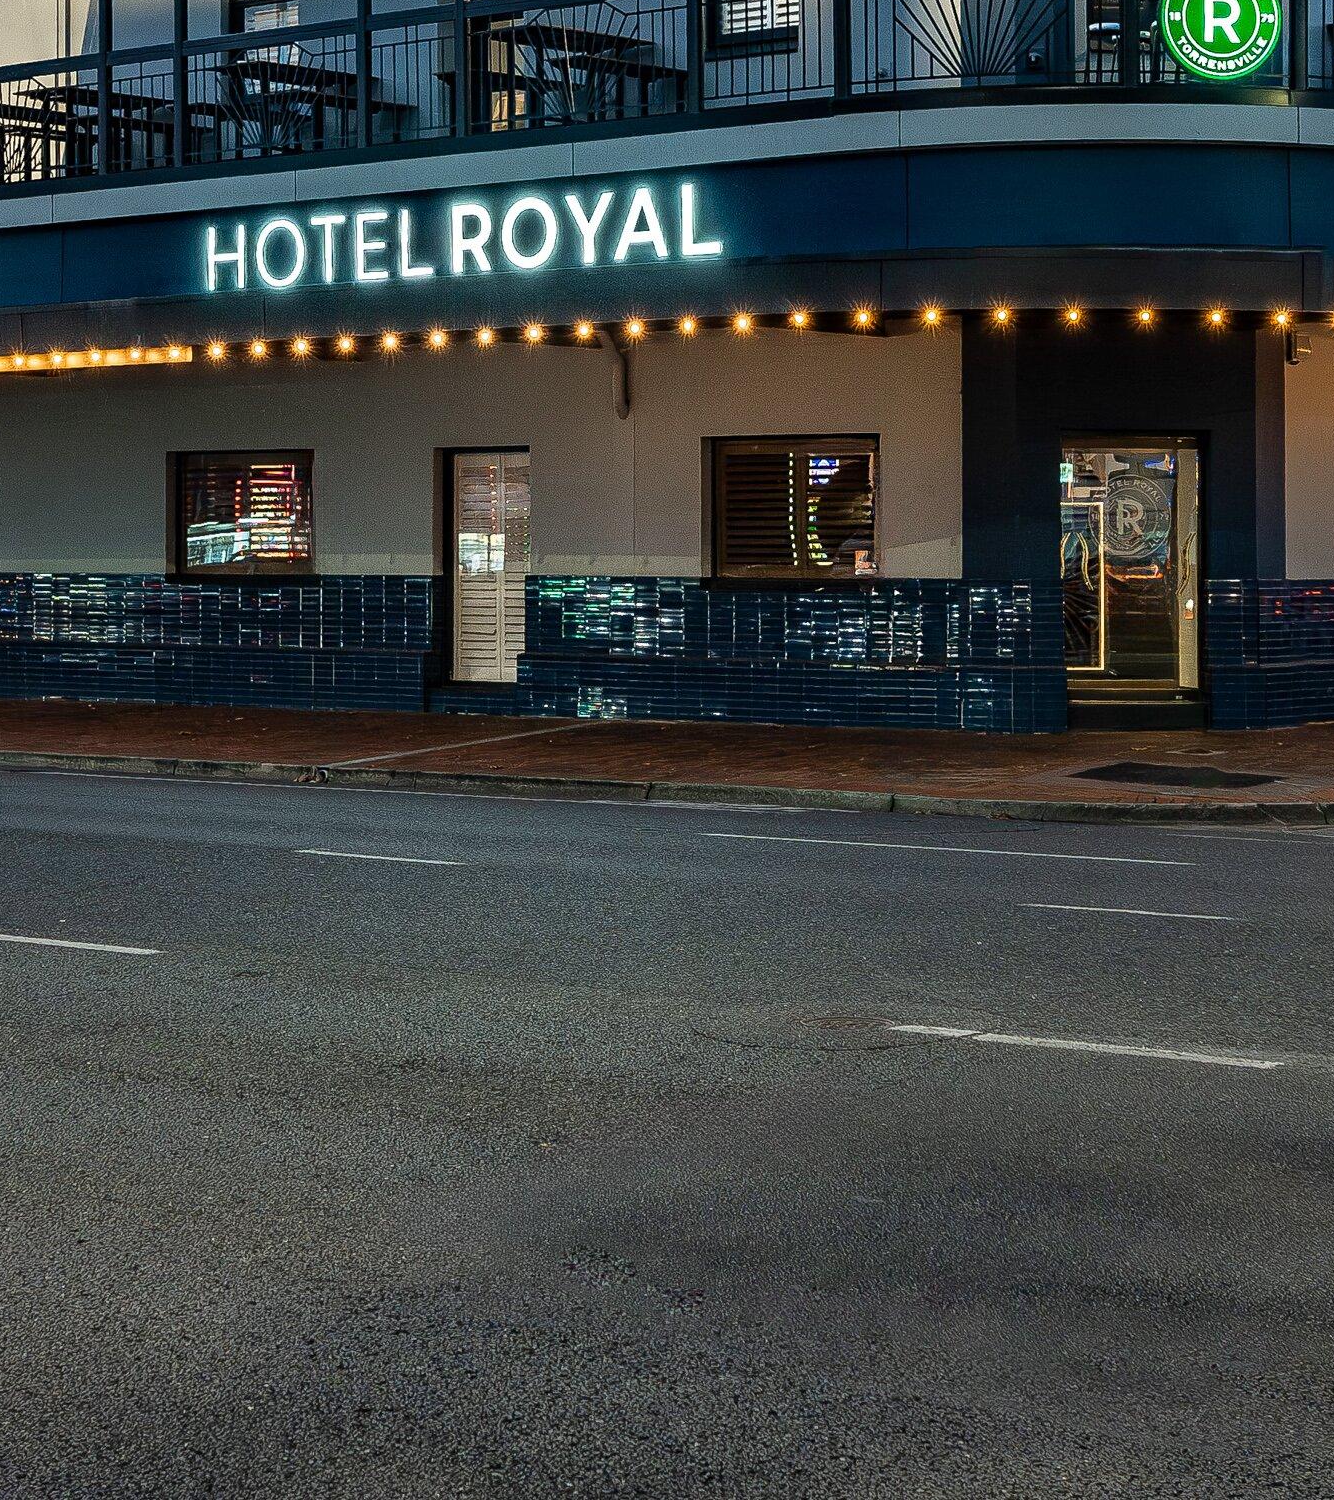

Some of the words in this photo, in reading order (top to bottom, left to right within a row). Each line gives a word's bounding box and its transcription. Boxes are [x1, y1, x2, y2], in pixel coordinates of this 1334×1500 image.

[1178, 36, 1267, 71] TORRENSVILLE
[205, 209, 434, 291] HOTEL
[451, 184, 723, 274] ROYAL
